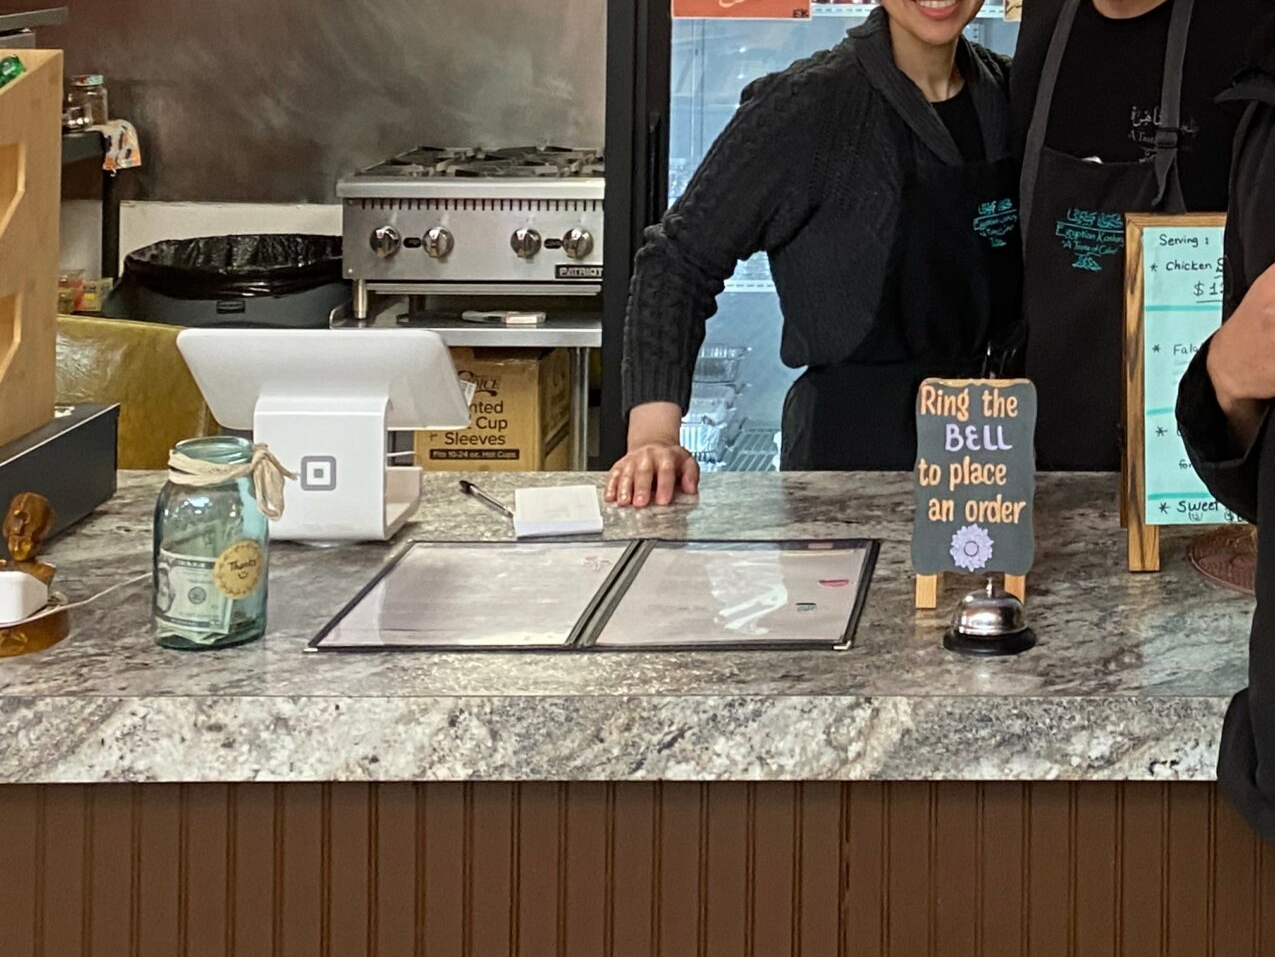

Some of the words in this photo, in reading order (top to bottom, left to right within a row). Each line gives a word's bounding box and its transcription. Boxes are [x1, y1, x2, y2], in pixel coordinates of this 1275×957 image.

[1159, 234, 1199, 248] Serving
[559, 267, 603, 277] PATRIOT
[1166, 260, 1212, 272] Chicken
[920, 385, 969, 422] Ring
[982, 388, 1018, 417] the
[476, 417, 508, 432] Cup
[445, 432, 505, 445] Sleeves
[945, 424, 1013, 452] BELL
[918, 458, 941, 486] to
[950, 456, 1007, 491] place
[928, 498, 954, 522] an
[965, 494, 1026, 524] order
